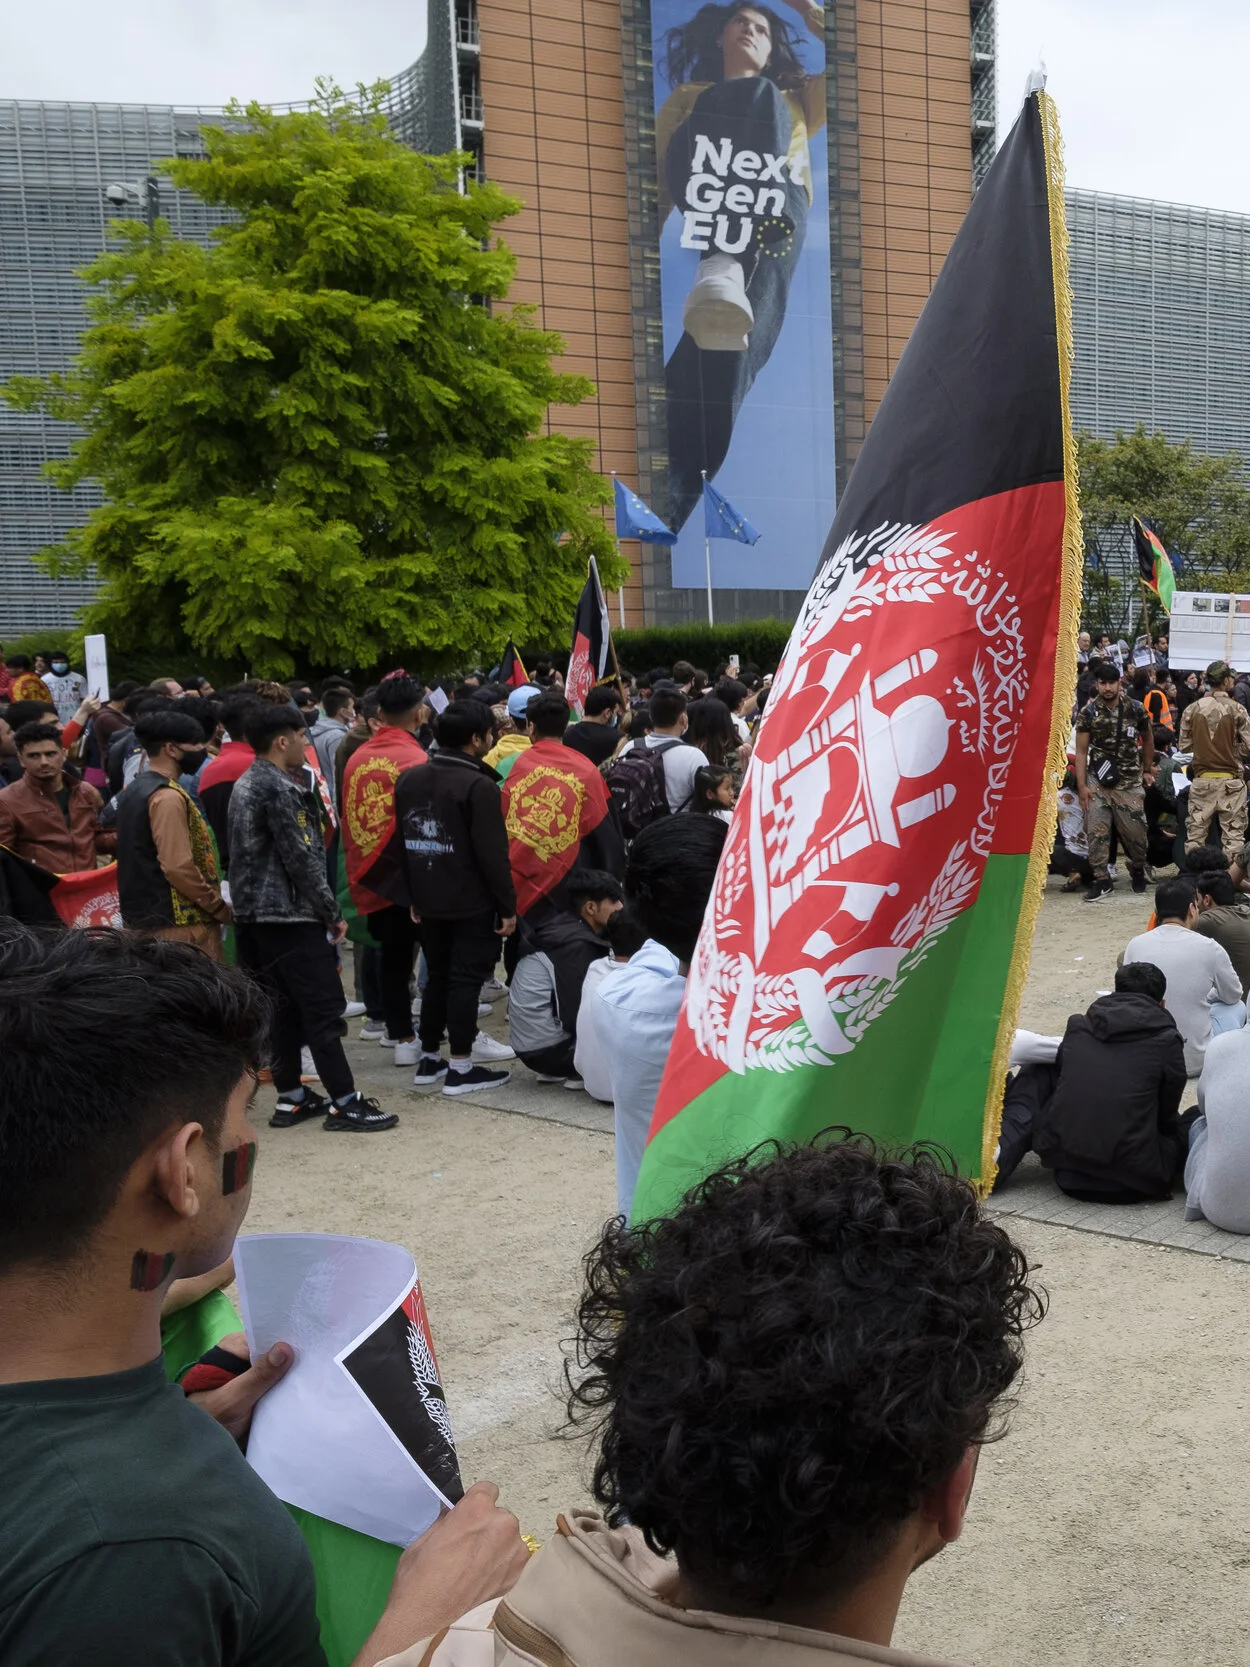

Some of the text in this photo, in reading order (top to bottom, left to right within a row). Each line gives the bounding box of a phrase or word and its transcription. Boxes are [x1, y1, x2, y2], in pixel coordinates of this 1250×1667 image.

[691, 134, 805, 185] Next
[685, 173, 786, 216] Gen
[680, 210, 753, 254] EU
